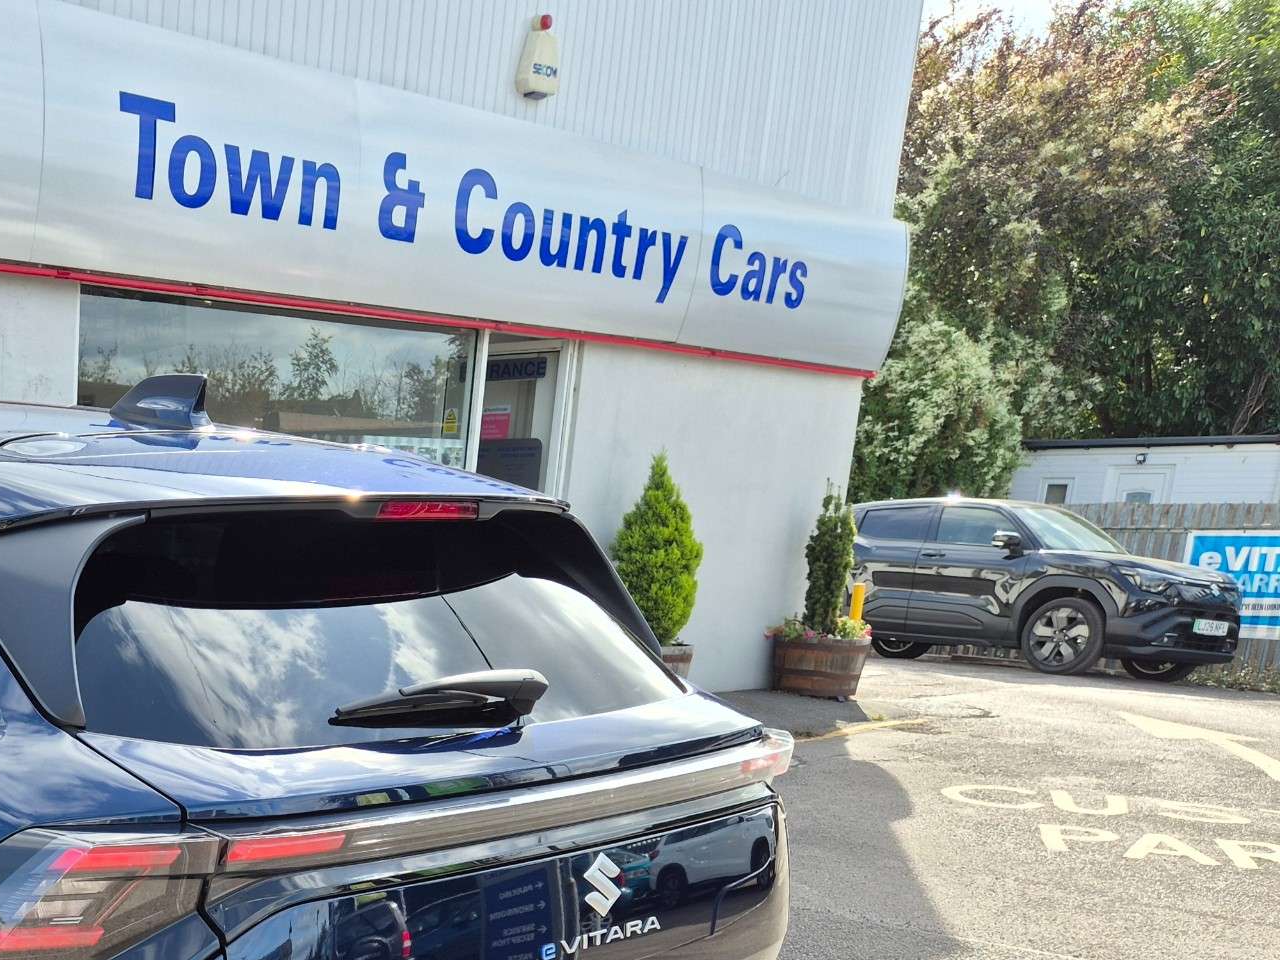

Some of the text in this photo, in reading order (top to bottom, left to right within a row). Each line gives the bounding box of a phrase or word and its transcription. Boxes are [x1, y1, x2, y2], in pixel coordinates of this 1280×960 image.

[119, 90, 809, 310] Town & Country Cars
[488, 360, 546, 378] RANCE
[1234, 573, 1280, 593] ARR
[941, 784, 1280, 824] CUS
[1037, 823, 1280, 869] PAR
